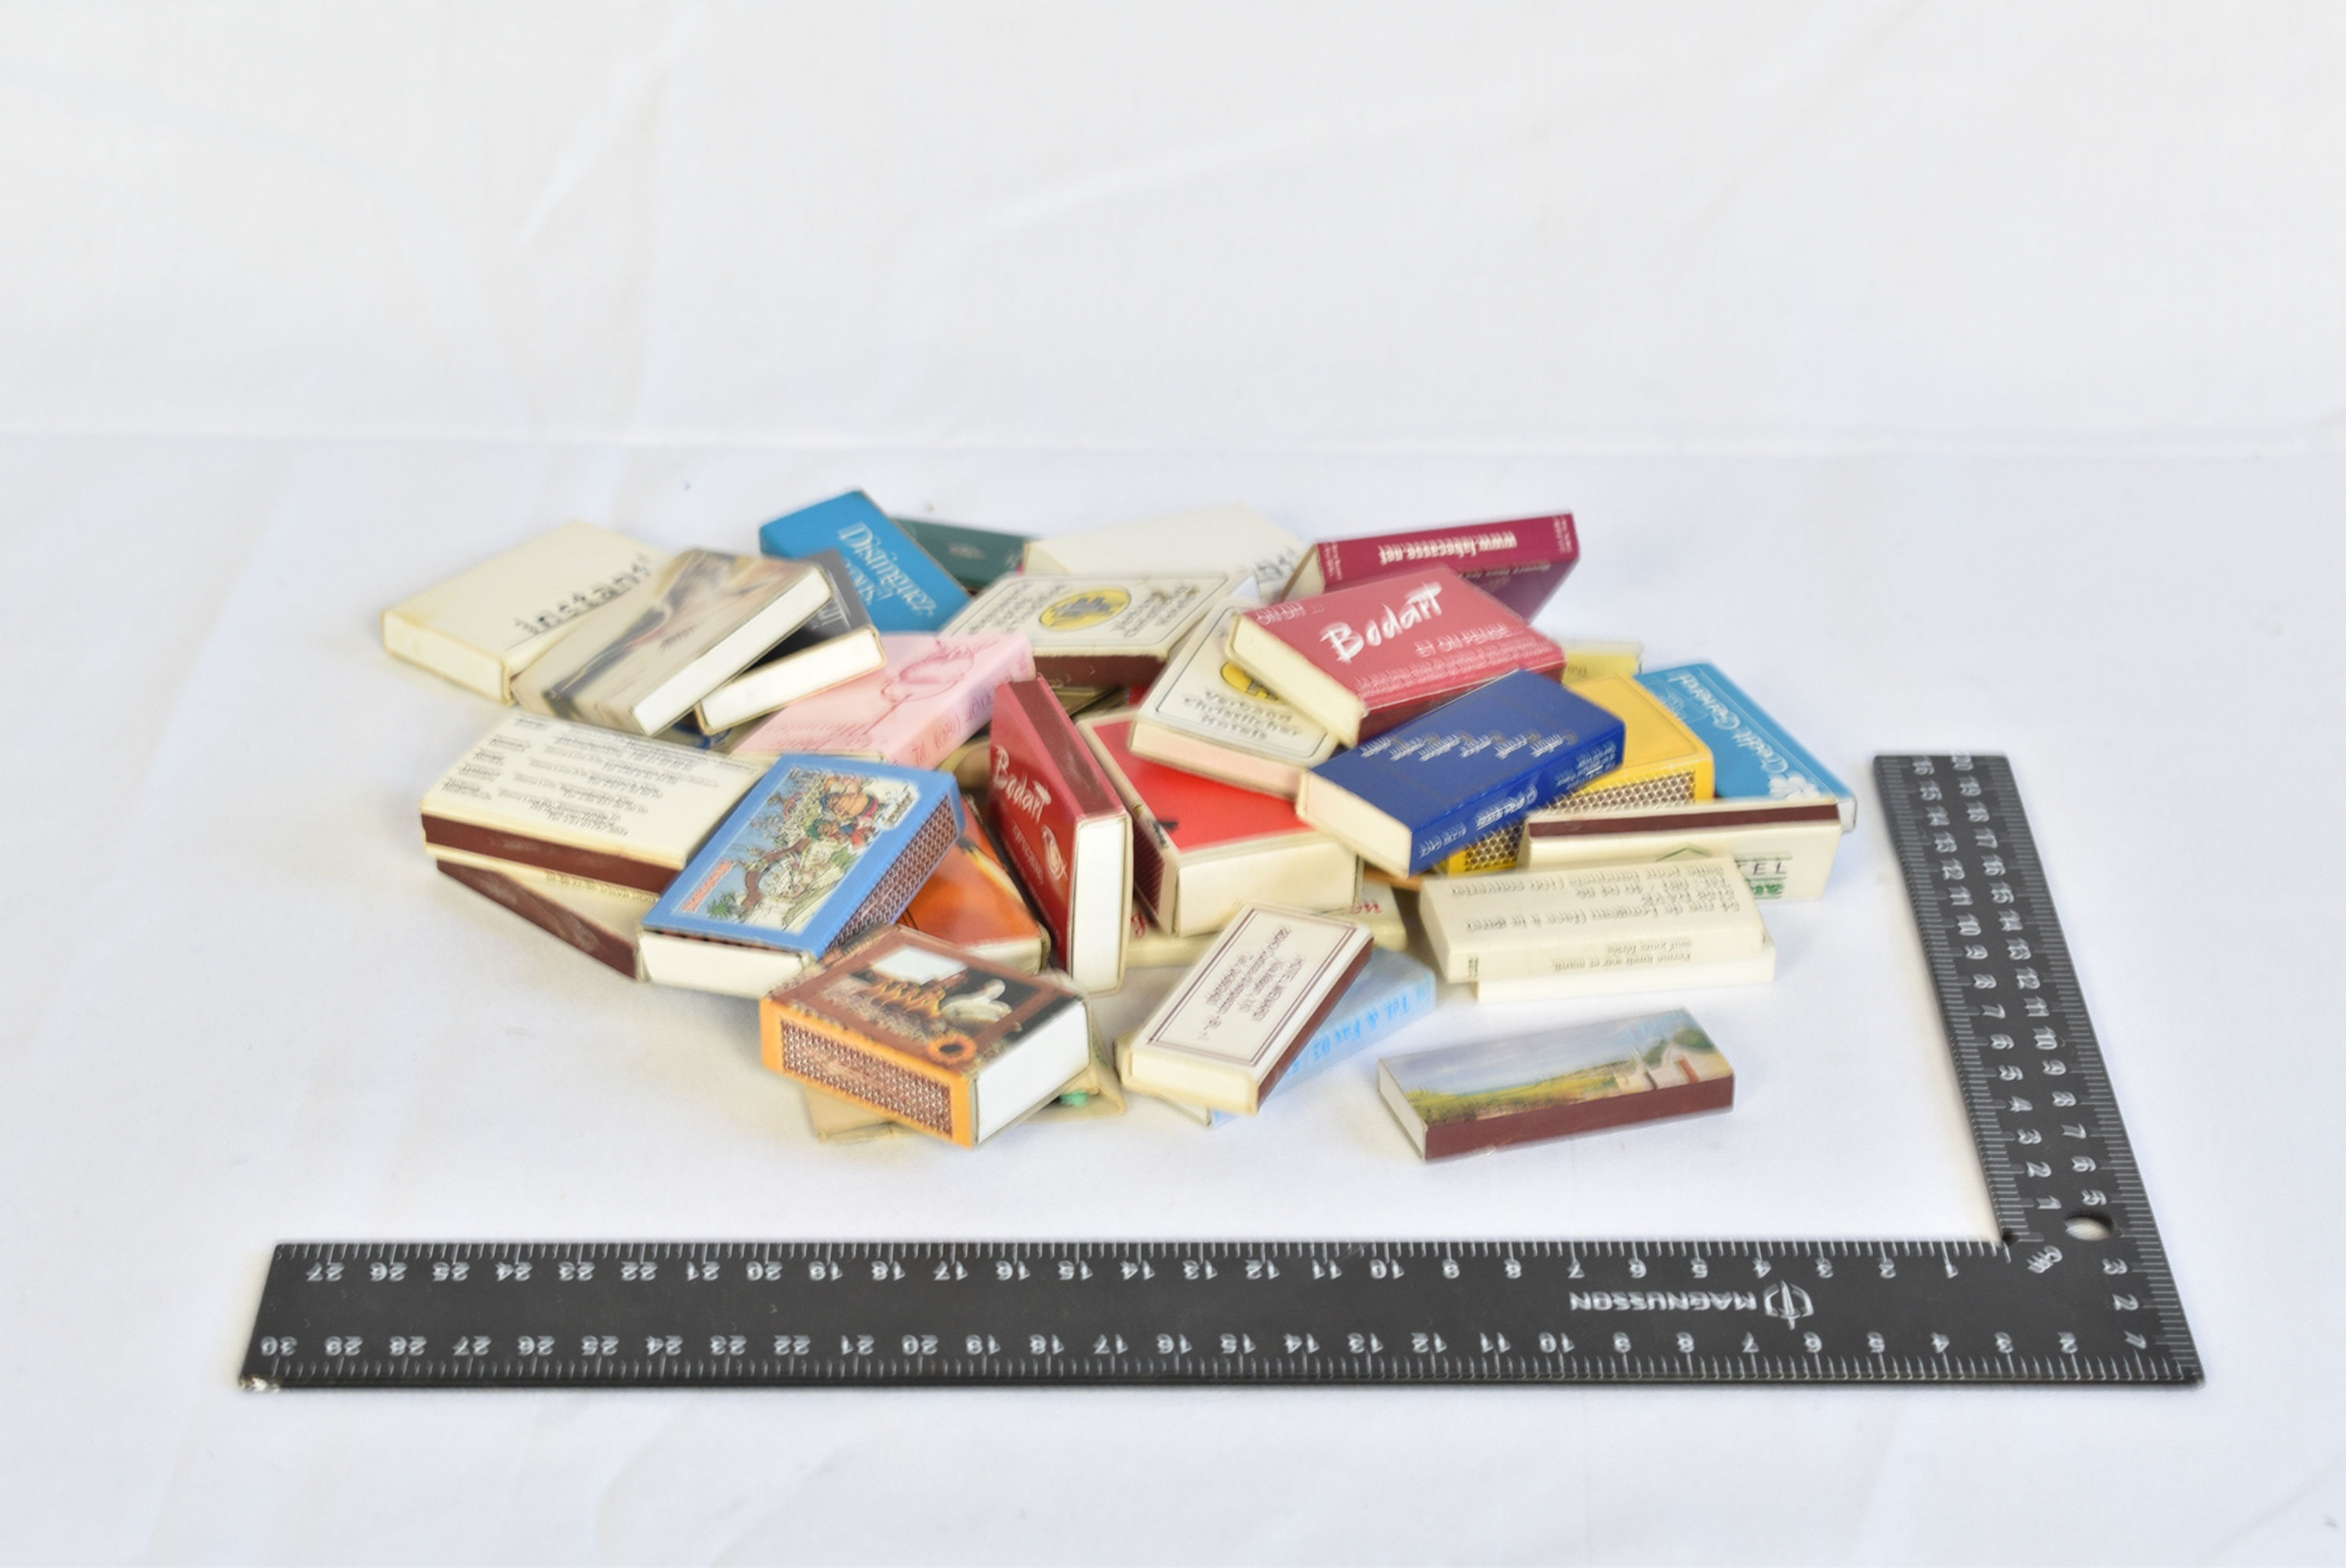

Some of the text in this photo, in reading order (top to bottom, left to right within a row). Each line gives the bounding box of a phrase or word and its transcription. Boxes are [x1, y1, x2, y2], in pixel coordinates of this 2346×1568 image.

[1319, 581, 1443, 665] Bodart
[993, 744, 1051, 823] Bodart
[1973, 827, 1998, 849] 17
[1956, 913, 1981, 936] 10
[2006, 938, 2032, 961] 13
[1973, 974, 1997, 989] 8
[2015, 966, 2040, 989] 12
[1981, 1004, 2006, 1019] 7
[2024, 996, 2050, 1017] 11
[1335, 1018, 1363, 1042] Fax
[2032, 1025, 2058, 1051] 10
[1990, 1033, 2014, 1050] 6
[1999, 1065, 2024, 1080] 5
[2042, 1059, 2067, 1076] 9
[2009, 1095, 2033, 1112] 4
[2052, 1091, 2076, 1107] 8
[2017, 1128, 2042, 1145] 3
[2061, 1123, 2086, 1139] 7
[2025, 1161, 2052, 1178] 2
[2071, 1156, 2097, 1173] 6
[2036, 1196, 2062, 1210] 1
[2080, 1189, 2107, 1206] 5
[307, 1261, 344, 1282] 27
[370, 1261, 408, 1282] 26
[433, 1261, 470, 1282] 25
[496, 1261, 533, 1282] 24
[559, 1261, 596, 1281] 23
[622, 1261, 658, 1281] 22
[687, 1261, 721, 1281] 21
[746, 1261, 783, 1281] 20
[809, 1261, 843, 1281] 19
[871, 1261, 906, 1281] 18
[934, 1260, 968, 1280] 17
[996, 1260, 1030, 1280] 16
[1058, 1260, 1092, 1280] 15
[1120, 1260, 1155, 1280] 14
[1183, 1260, 1218, 1280] 13
[1244, 1260, 1280, 1280] 12
[1313, 1260, 1342, 1280] 11
[1371, 1259, 1404, 1279] 10
[1504, 1259, 1522, 1279] 8
[1569, 1259, 1585, 1279] 7
[1629, 1259, 1647, 1279] 6
[1691, 1259, 1708, 1279] 5
[1753, 1258, 1771, 1279] 4
[1815, 1258, 1833, 1279] 3
[1879, 1258, 1896, 1279] 2
[1945, 1258, 1959, 1279] 1
[2102, 1258, 2127, 1276] 3
[1569, 1290, 1757, 1311] MAGNUSSON
[2112, 1294, 2139, 1311] 2
[260, 1336, 297, 1356] 30
[453, 1335, 492, 1356] 27
[518, 1335, 555, 1356] 26
[581, 1335, 619, 1356] 25
[645, 1335, 683, 1356] 24
[710, 1335, 746, 1356] 23
[774, 1335, 810, 1356] 22
[841, 1334, 874, 1355] 21
[902, 1334, 939, 1355] 20
[965, 1334, 1001, 1355] 19
[1030, 1334, 1065, 1355] 18
[1093, 1334, 1128, 1355] 17
[1157, 1334, 1192, 1355] 16
[1220, 1334, 1255, 1354] 15
[1284, 1334, 1320, 1354] 14
[1348, 1334, 1383, 1354] 13
[1411, 1334, 1447, 1354] 12
[1480, 1334, 1510, 1354] 11
[1539, 1333, 1574, 1353] 10
[1676, 1333, 1694, 1353] 8
[1742, 1333, 1759, 1353] 7
[1804, 1333, 1822, 1353] 6
[1867, 1333, 1885, 1353] 5
[1930, 1332, 1949, 1352] 4
[1995, 1332, 2013, 1352] 3
[2058, 1332, 2078, 1352] 2
[2124, 1330, 2148, 1349] 1
